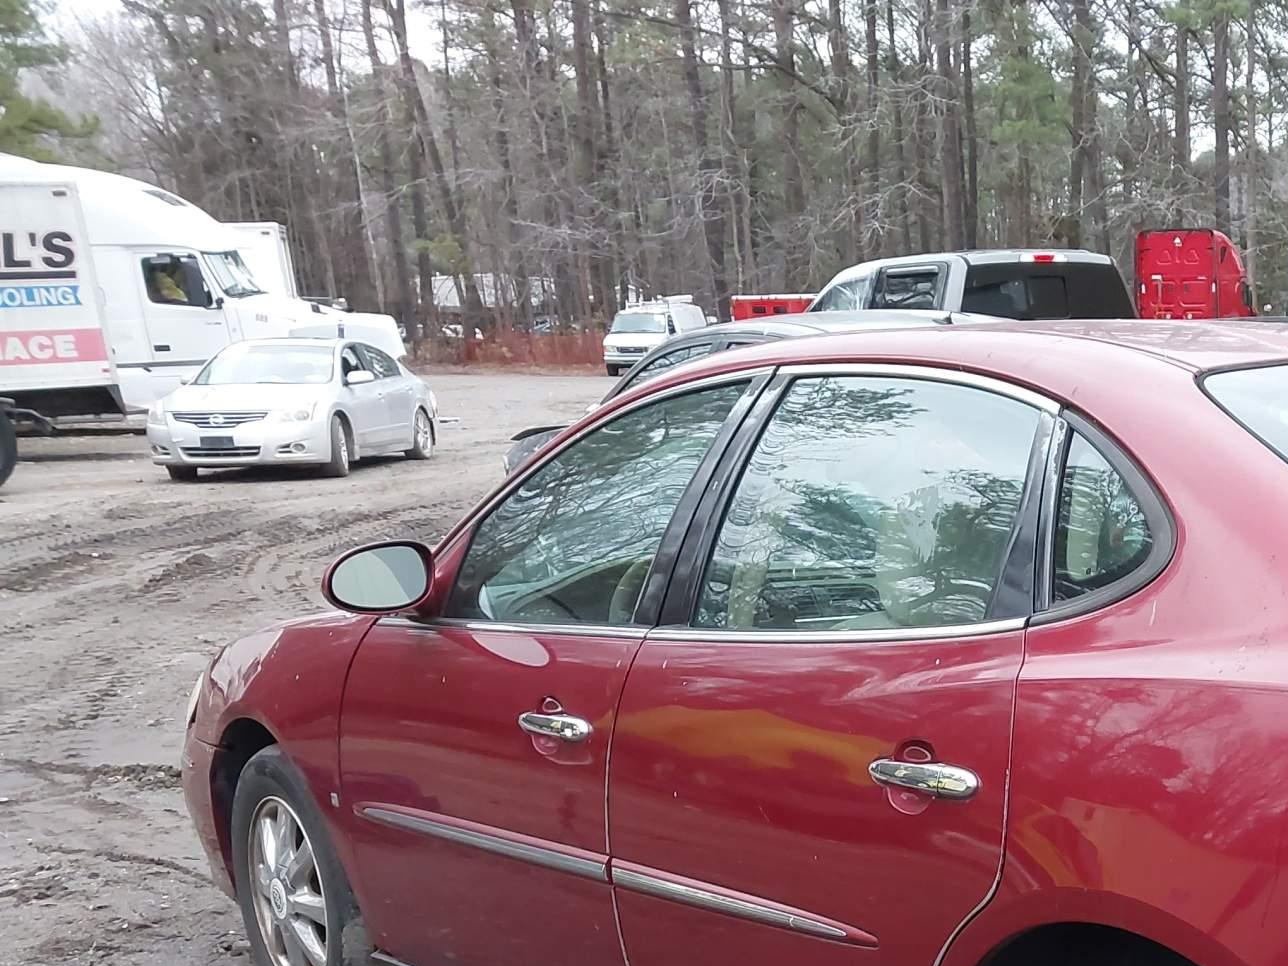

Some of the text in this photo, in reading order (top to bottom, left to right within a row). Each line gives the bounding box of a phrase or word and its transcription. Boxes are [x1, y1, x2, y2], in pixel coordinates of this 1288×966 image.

[0, 231, 75, 268] L'S
[0, 286, 77, 307] OLING
[0, 334, 79, 361] ACE
